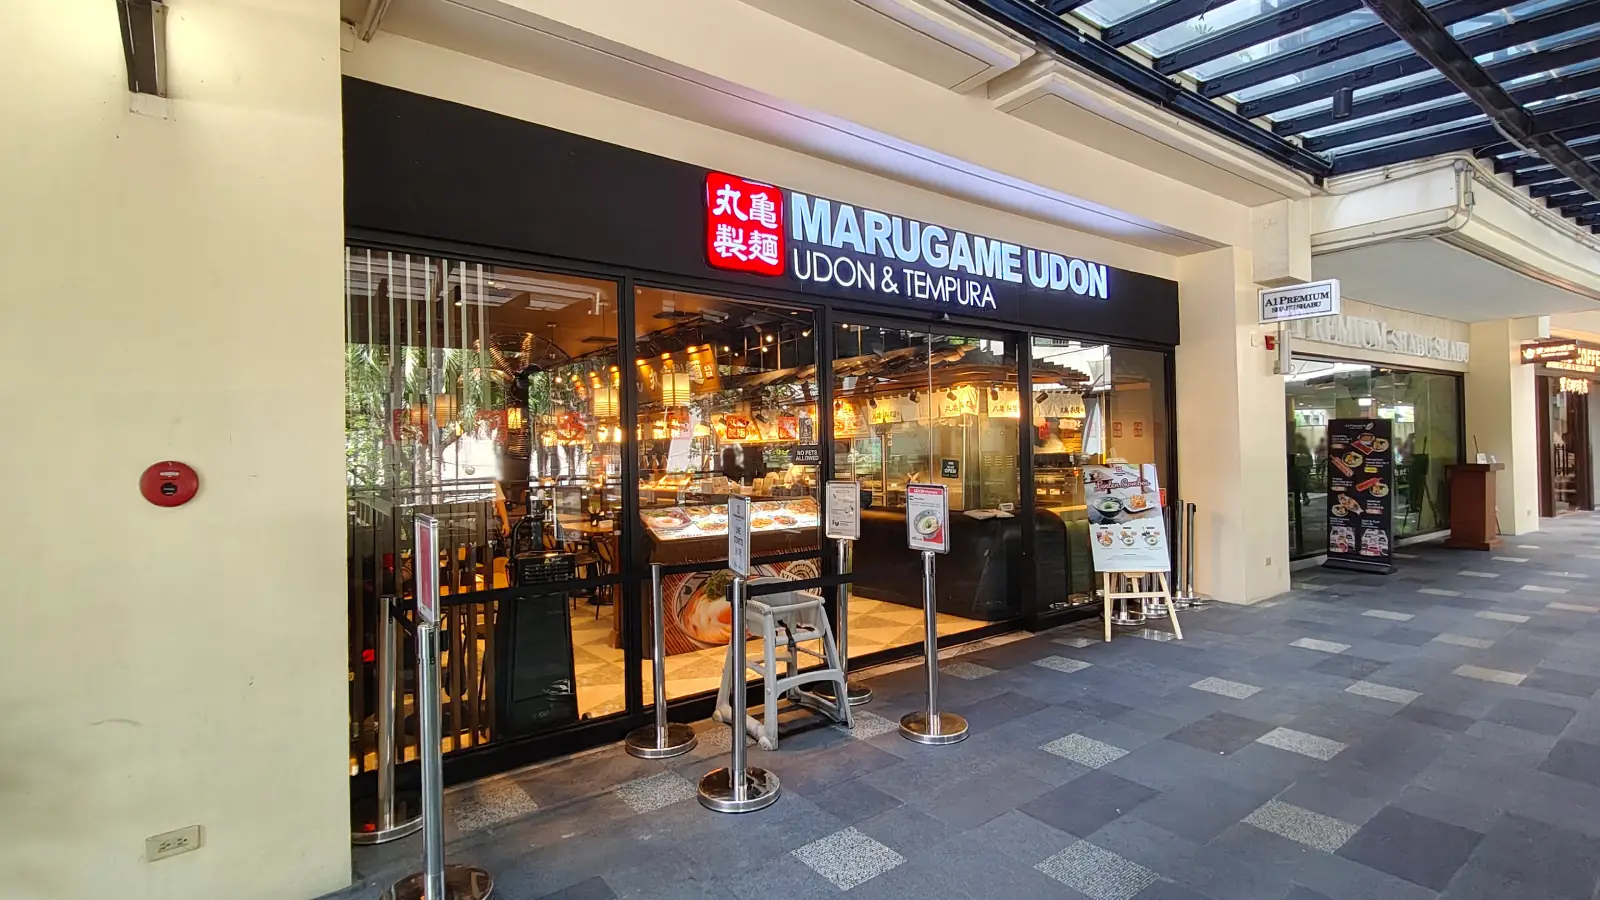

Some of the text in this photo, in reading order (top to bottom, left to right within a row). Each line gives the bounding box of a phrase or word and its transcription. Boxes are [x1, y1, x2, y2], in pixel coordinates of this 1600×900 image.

[712, 183, 777, 229] 丸亀
[713, 224, 779, 266] 製麺
[791, 192, 1108, 299] MARUGAME UDON
[794, 249, 997, 310] UDON & TEMPURA
[1265, 291, 1330, 307] A1 PREMIUM
